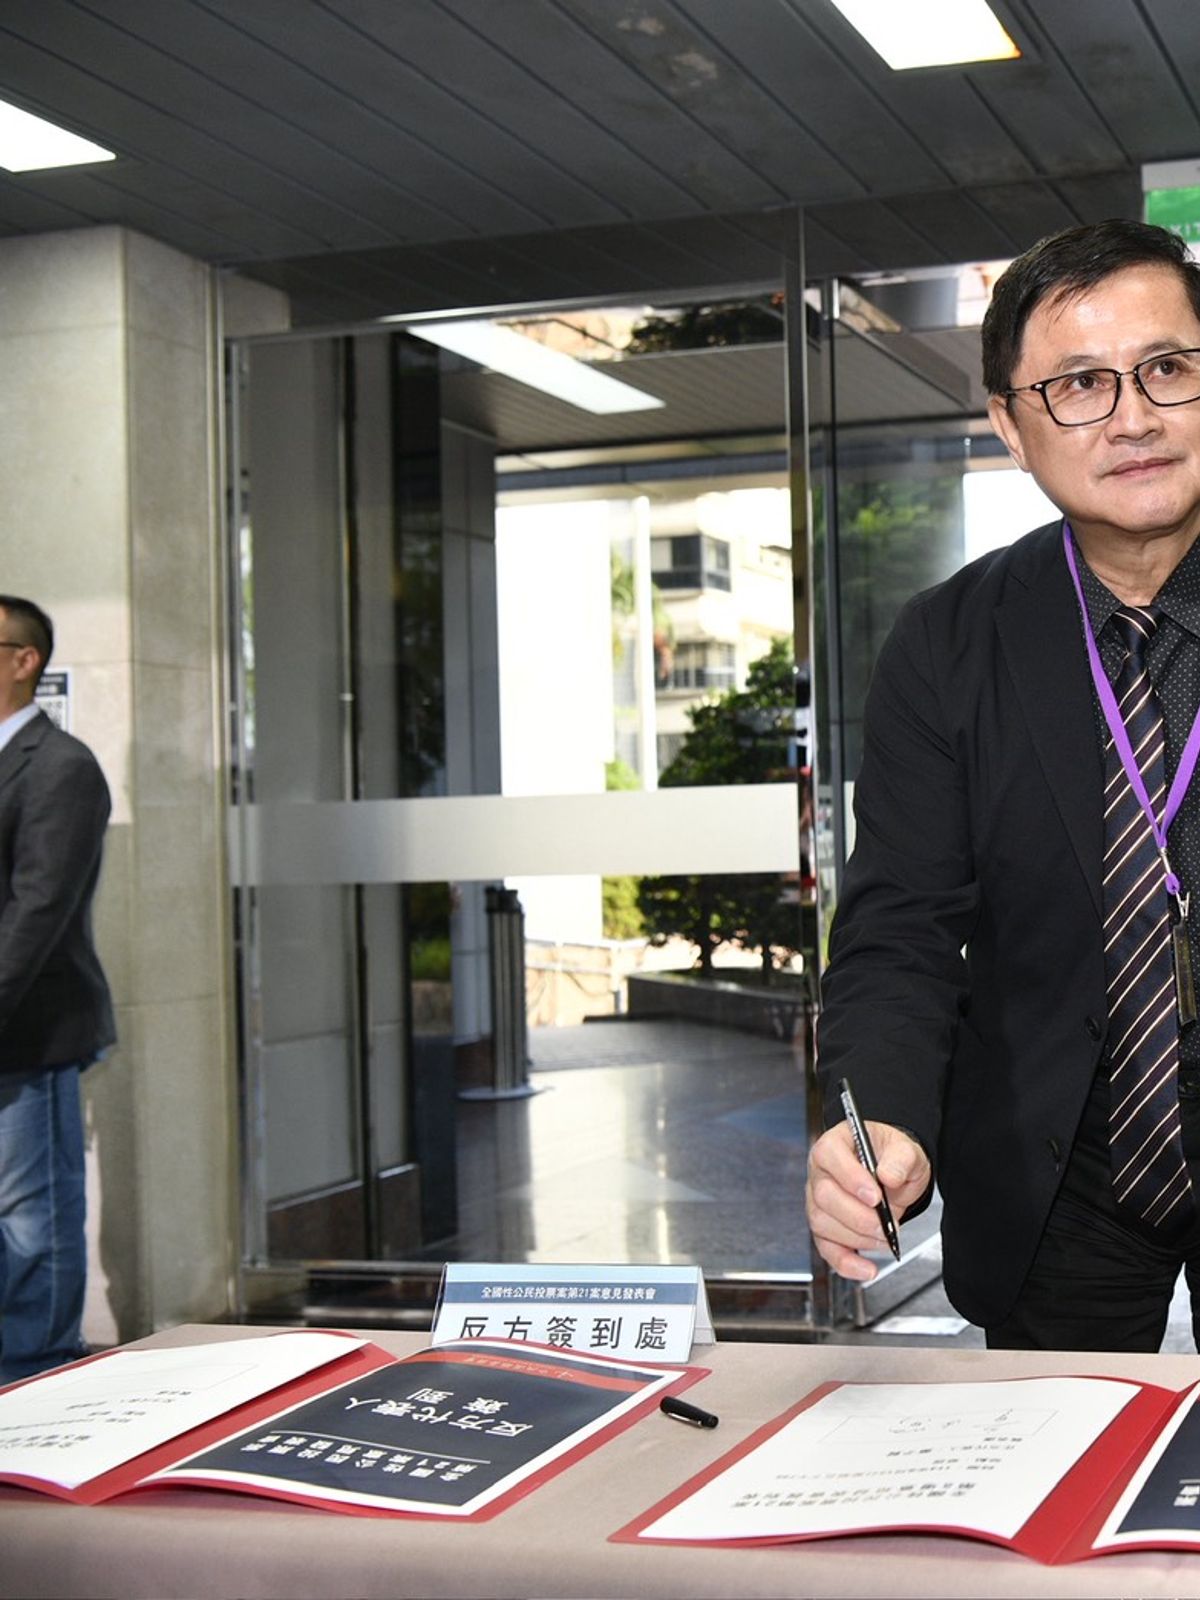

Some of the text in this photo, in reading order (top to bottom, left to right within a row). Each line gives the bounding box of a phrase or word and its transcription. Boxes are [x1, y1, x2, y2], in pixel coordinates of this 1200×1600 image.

[481, 1287, 657, 1301] 全國性公民投票案第21案意見發表會
[343, 1396, 534, 1438] 反方代表人
